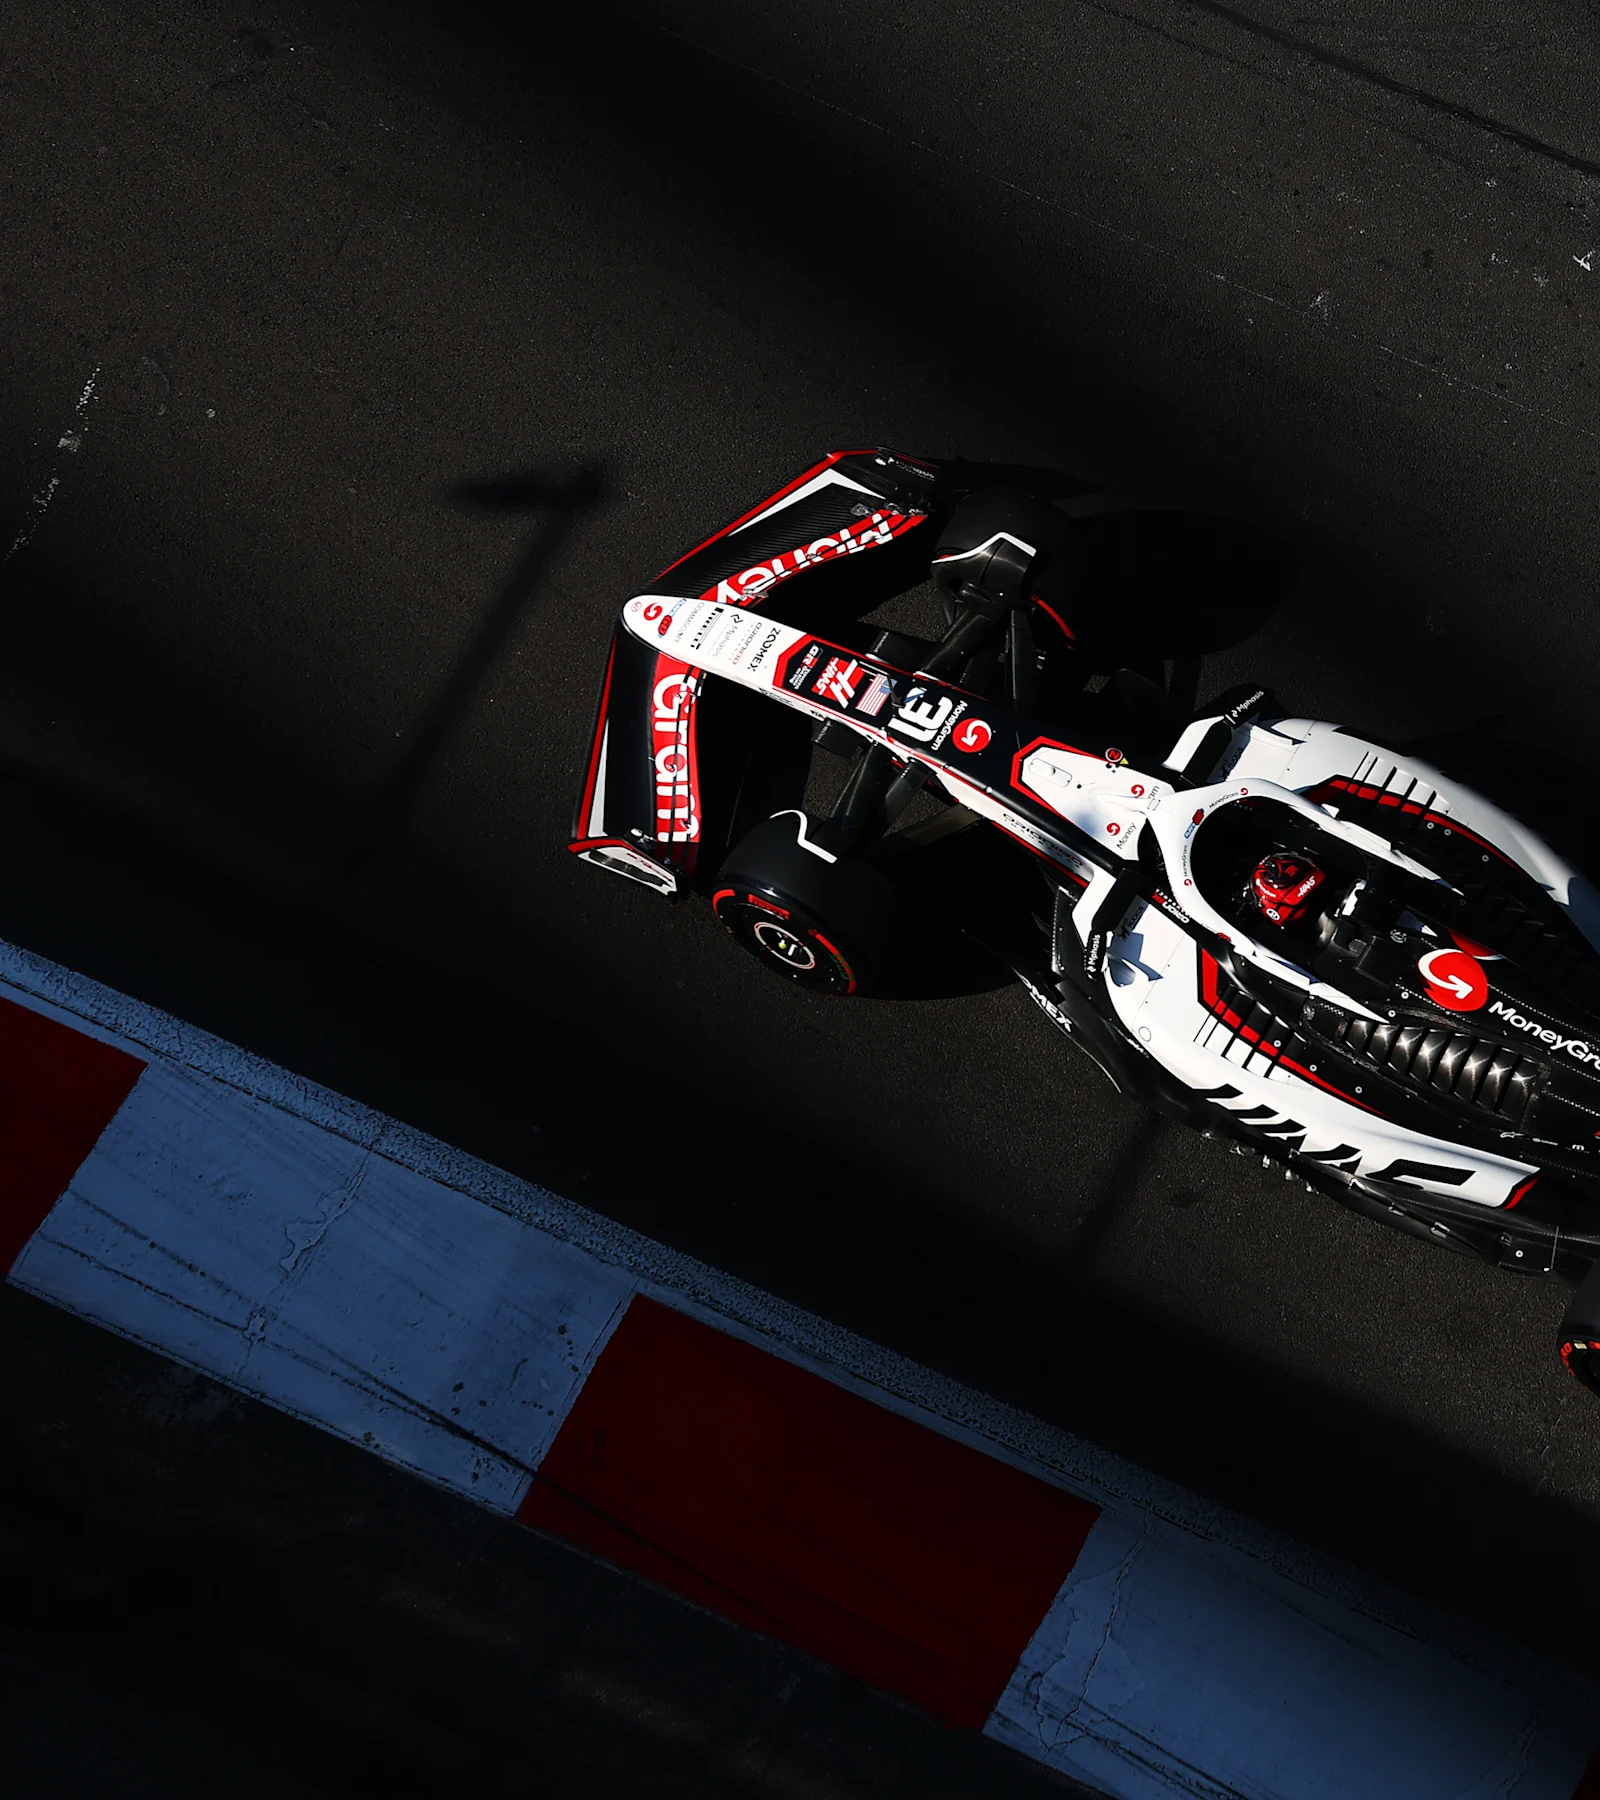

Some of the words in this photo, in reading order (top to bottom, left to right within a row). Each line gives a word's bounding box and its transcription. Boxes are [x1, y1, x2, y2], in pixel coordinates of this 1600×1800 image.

[690, 606, 724, 650] PIRELLI
[712, 626, 738, 658] Mphasis
[747, 627, 781, 672] ZOOMEX
[815, 656, 841, 696] HAAS
[888, 684, 953, 743] 31
[1236, 689, 1265, 713] Mphasis
[931, 700, 968, 751] MoneyGram
[1087, 934, 1101, 965] Mphasis
